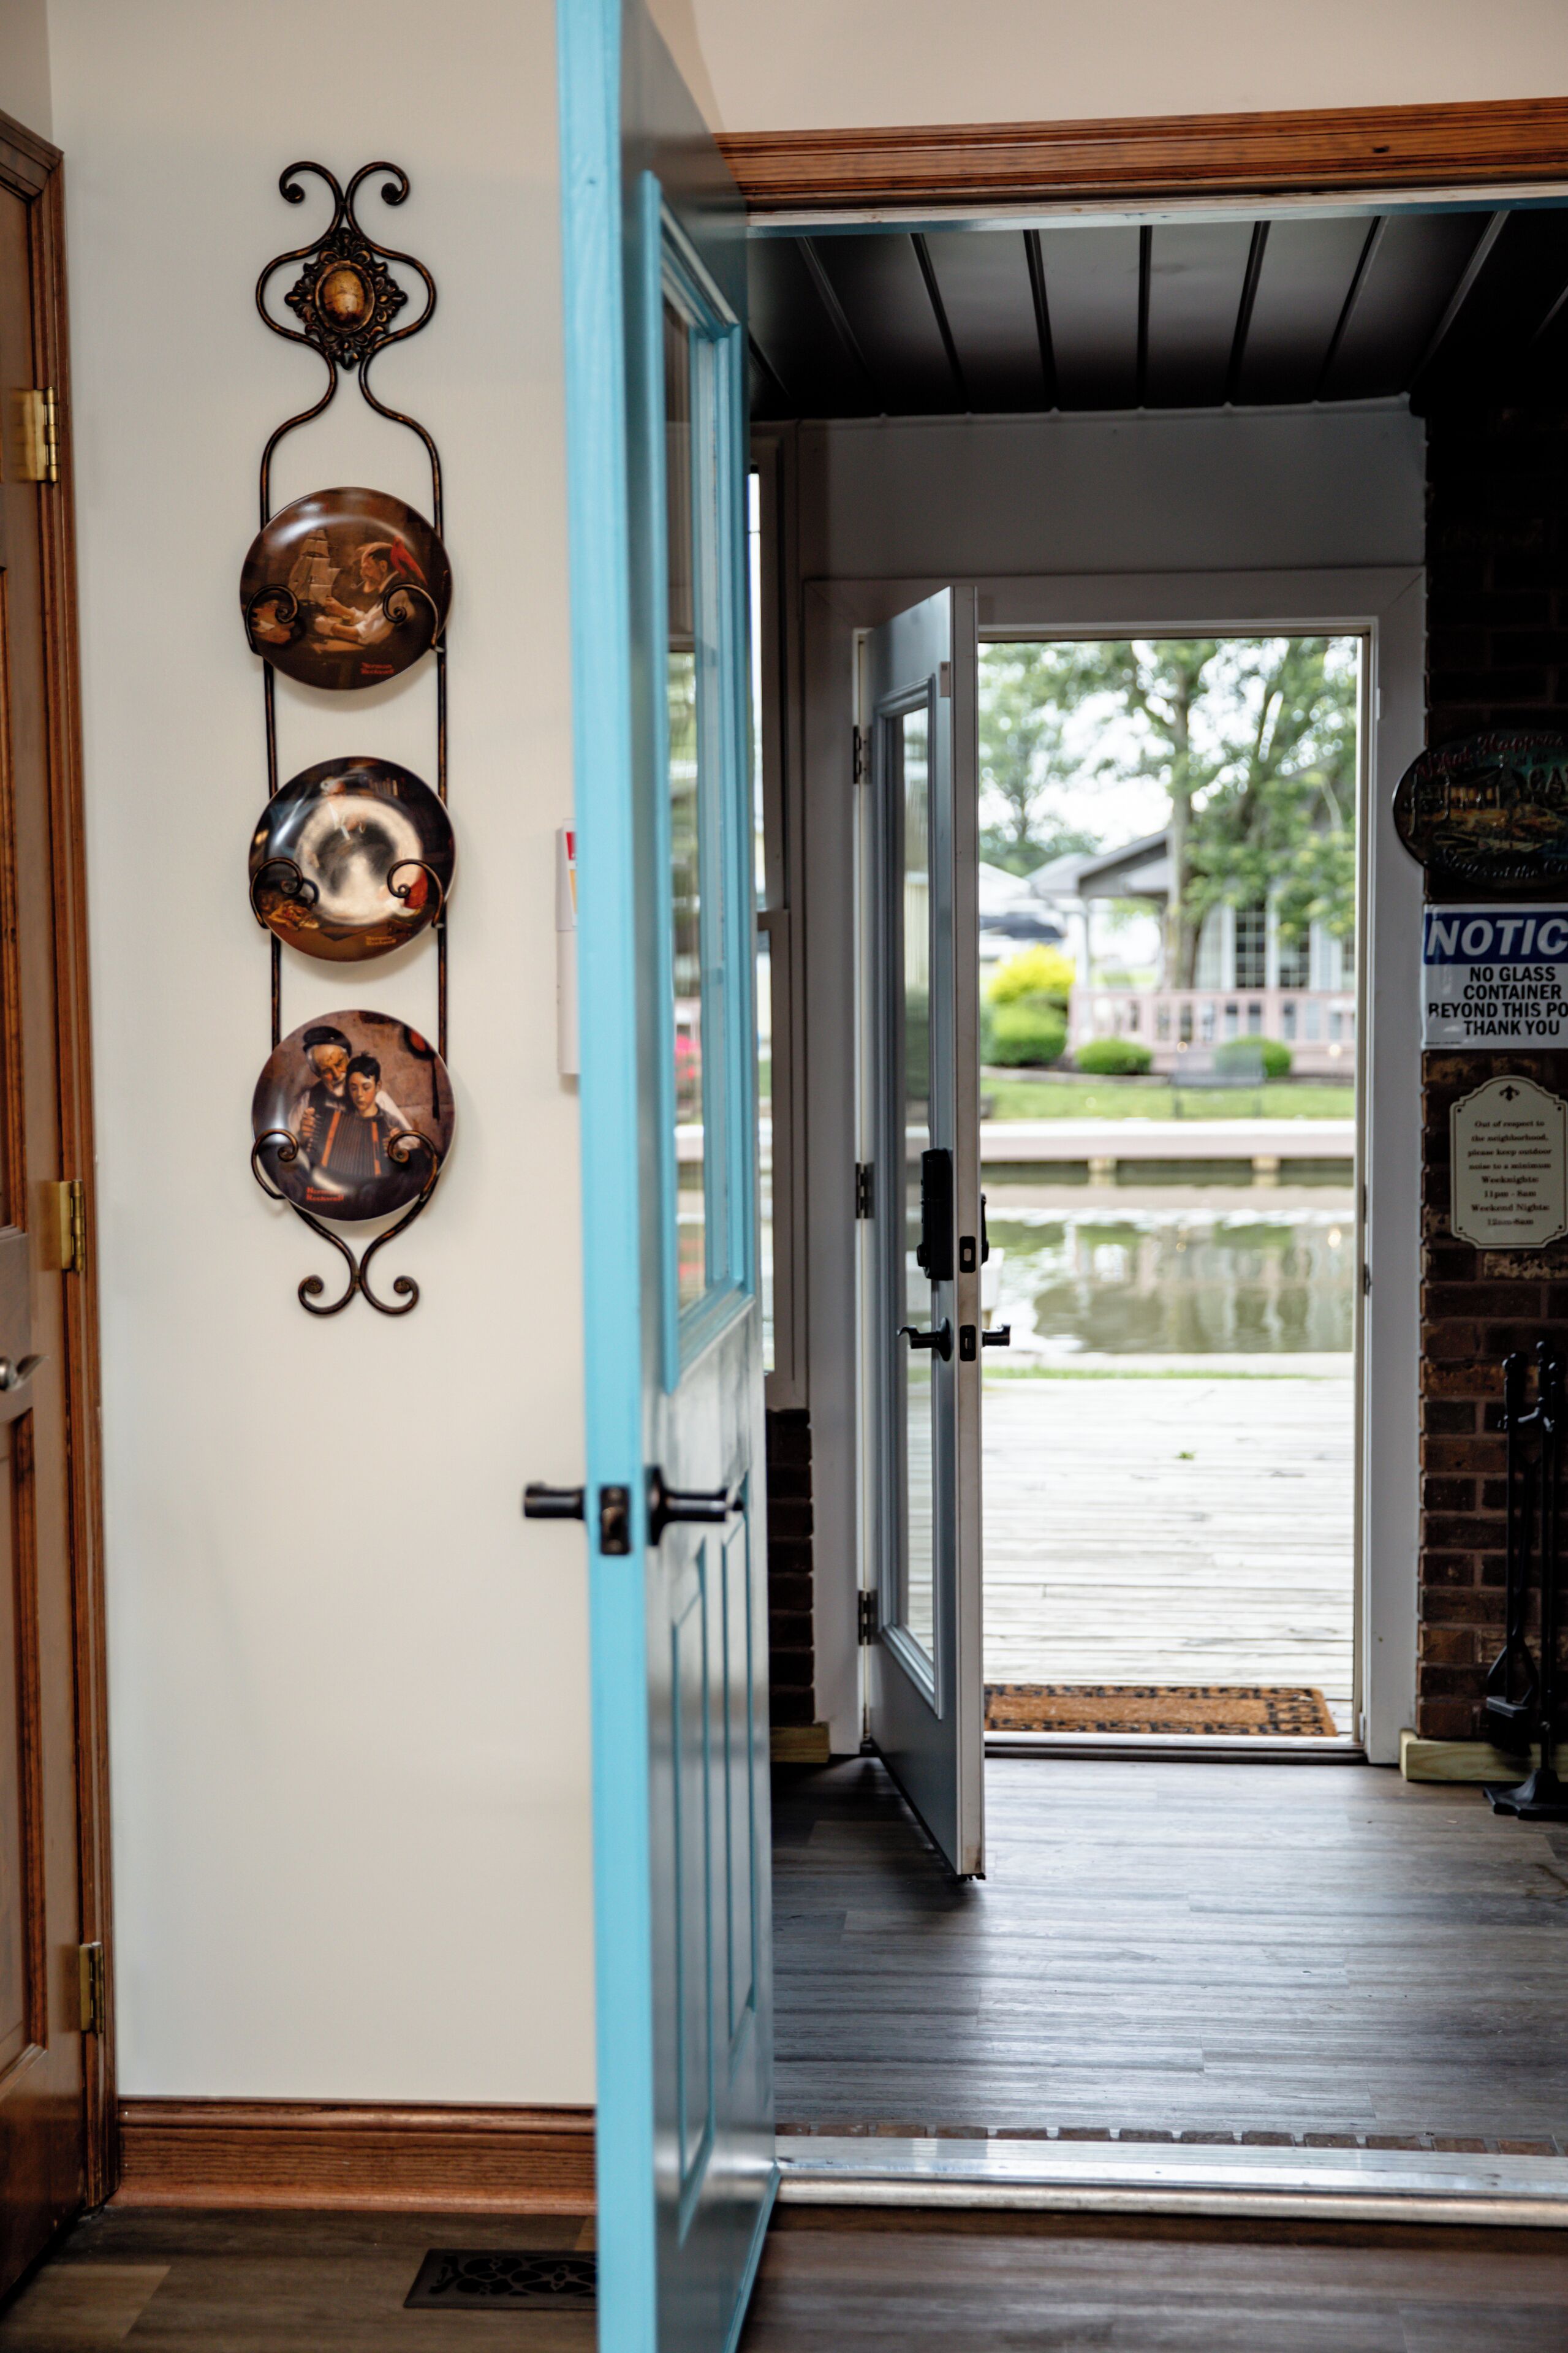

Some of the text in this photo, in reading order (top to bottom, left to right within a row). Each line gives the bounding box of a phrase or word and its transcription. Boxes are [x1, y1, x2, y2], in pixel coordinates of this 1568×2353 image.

[1426, 919, 1568, 955] NOTIC
[1470, 966, 1556, 982] NO GLASS
[1463, 984, 1562, 1000] CONTAINER
[1502, 1002, 1541, 1018] THIS
[1464, 1020, 1559, 1036] THANK YOU
[1468, 1149, 1494, 1158] please
[1496, 1148, 1517, 1156] keep
[1481, 1175, 1539, 1184] Weeknights:
[1484, 1190, 1509, 1199] 11pm
[1517, 1203, 1550, 1212] Nights:
